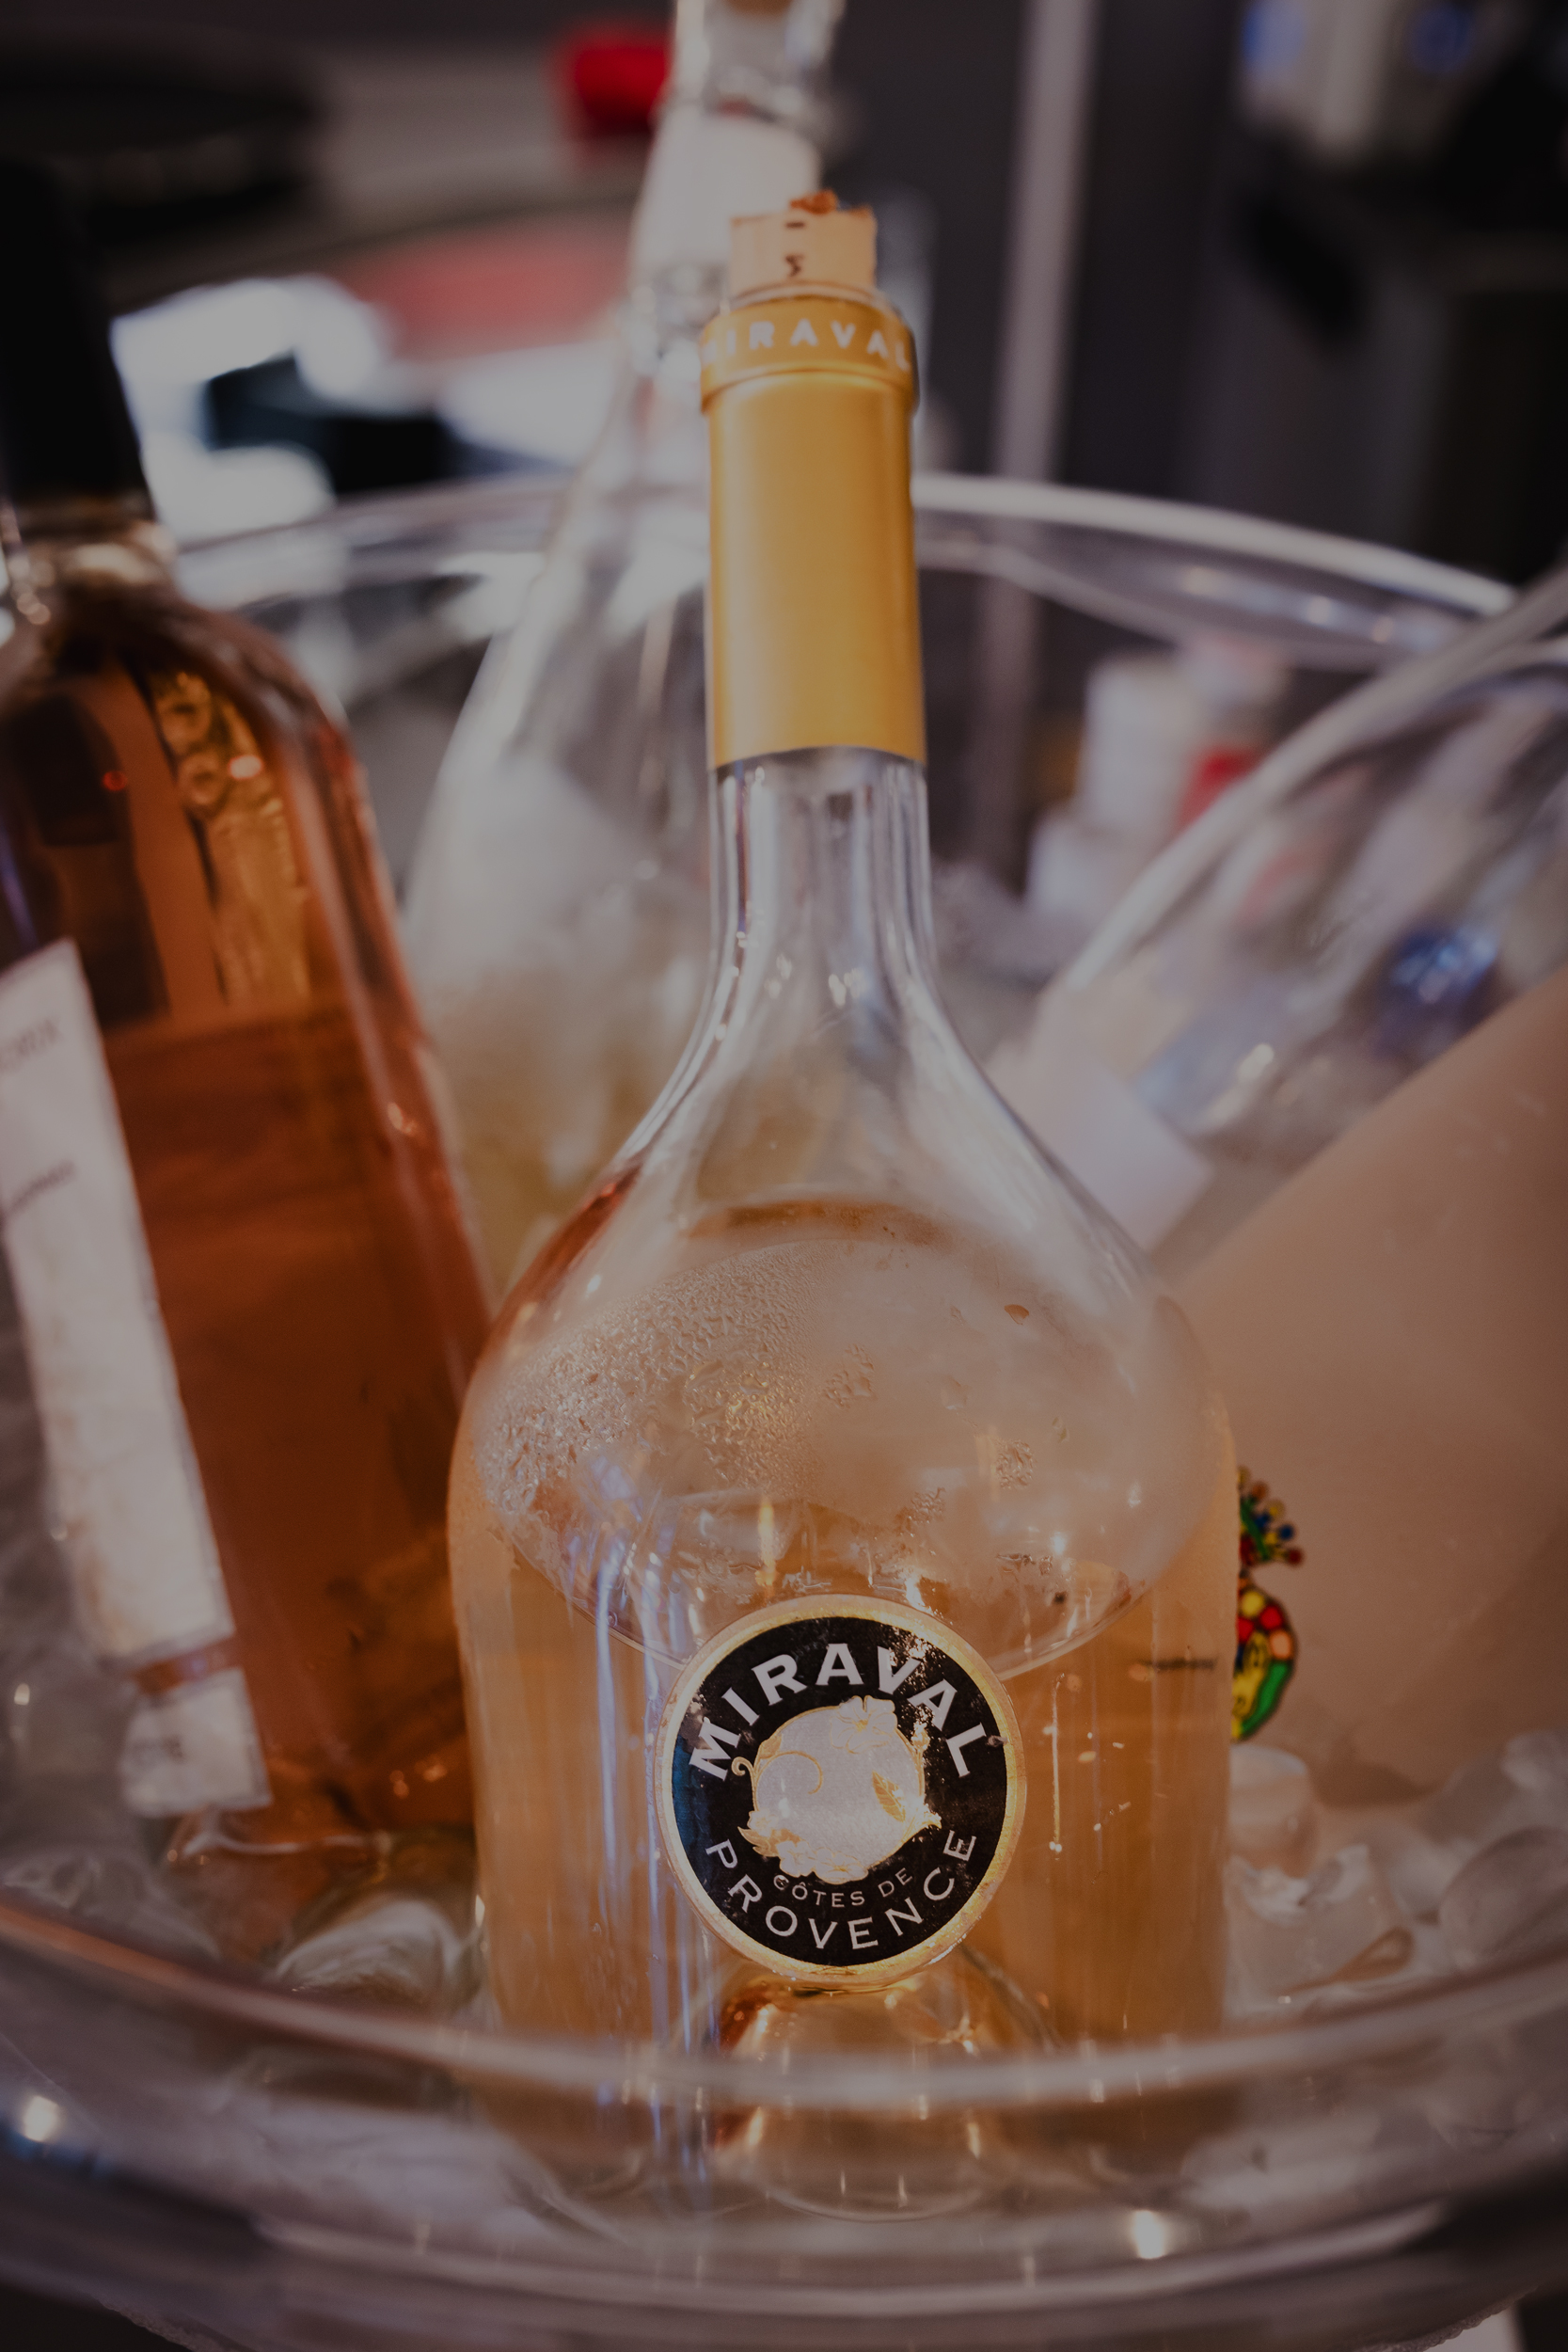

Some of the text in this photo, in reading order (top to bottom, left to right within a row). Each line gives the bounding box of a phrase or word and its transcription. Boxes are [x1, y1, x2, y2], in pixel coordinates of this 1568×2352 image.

[689, 1643, 987, 1781] MIRAVAL
[705, 1830, 977, 1950] PROVENCE
[773, 1867, 913, 1908] CÔTES DE
